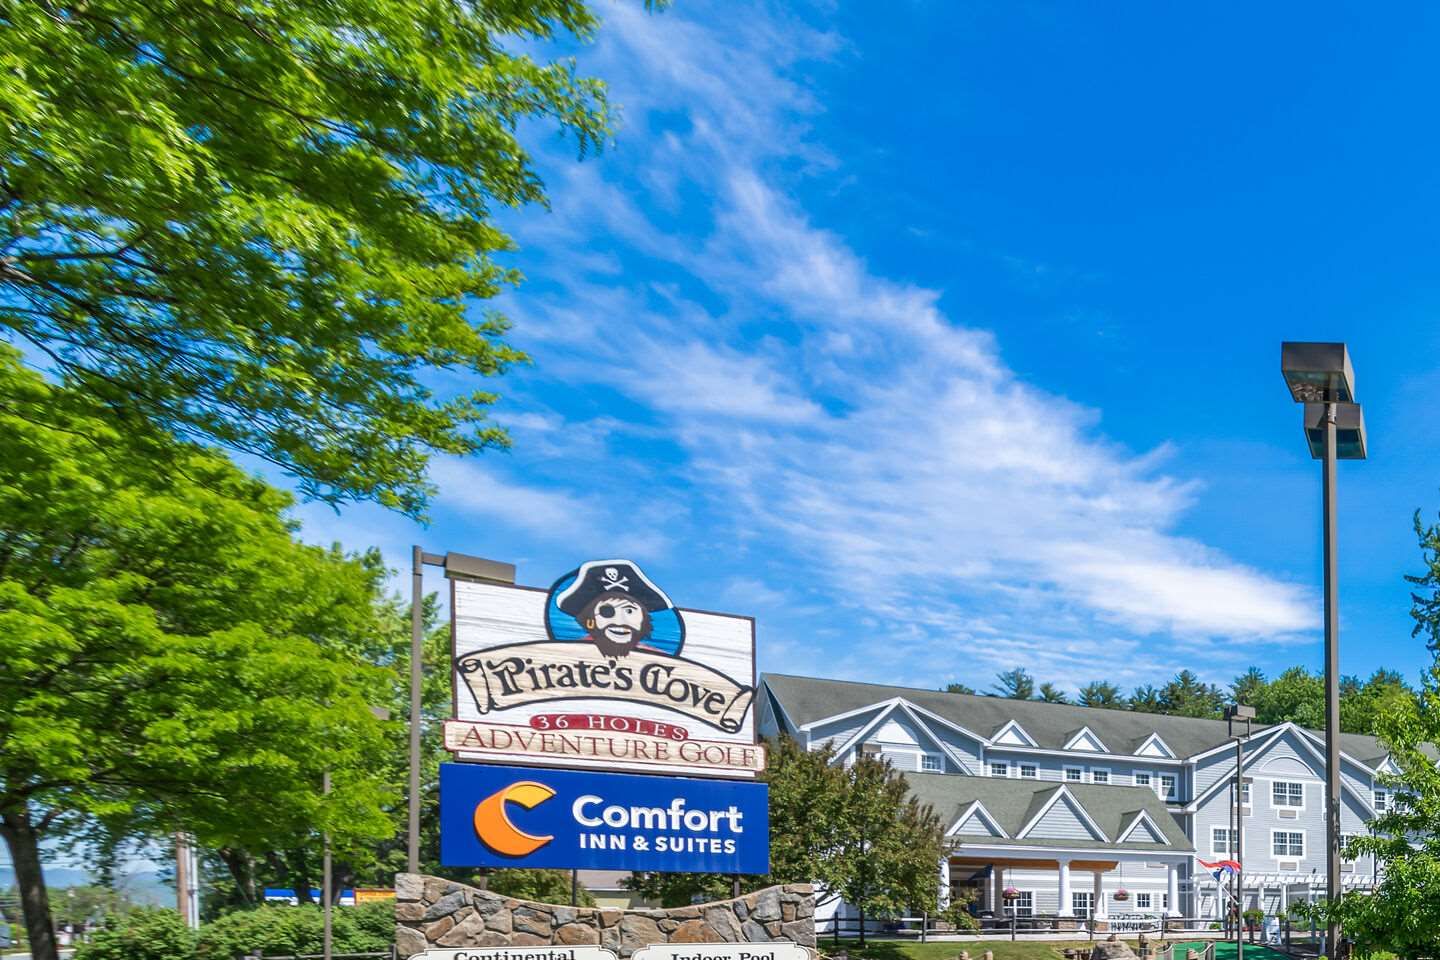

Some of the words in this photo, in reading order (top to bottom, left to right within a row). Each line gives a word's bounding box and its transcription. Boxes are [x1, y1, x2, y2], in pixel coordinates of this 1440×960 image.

[487, 657, 633, 697] Pirate's
[639, 663, 725, 715] Cove
[461, 725, 671, 761] ADVENTURE
[679, 742, 756, 767] GOLF
[538, 715, 570, 730] 36
[588, 715, 688, 741] HOLES
[572, 794, 744, 833] Comfort
[579, 833, 626, 850] INN
[632, 835, 650, 851] &
[655, 836, 737, 854] SUITES
